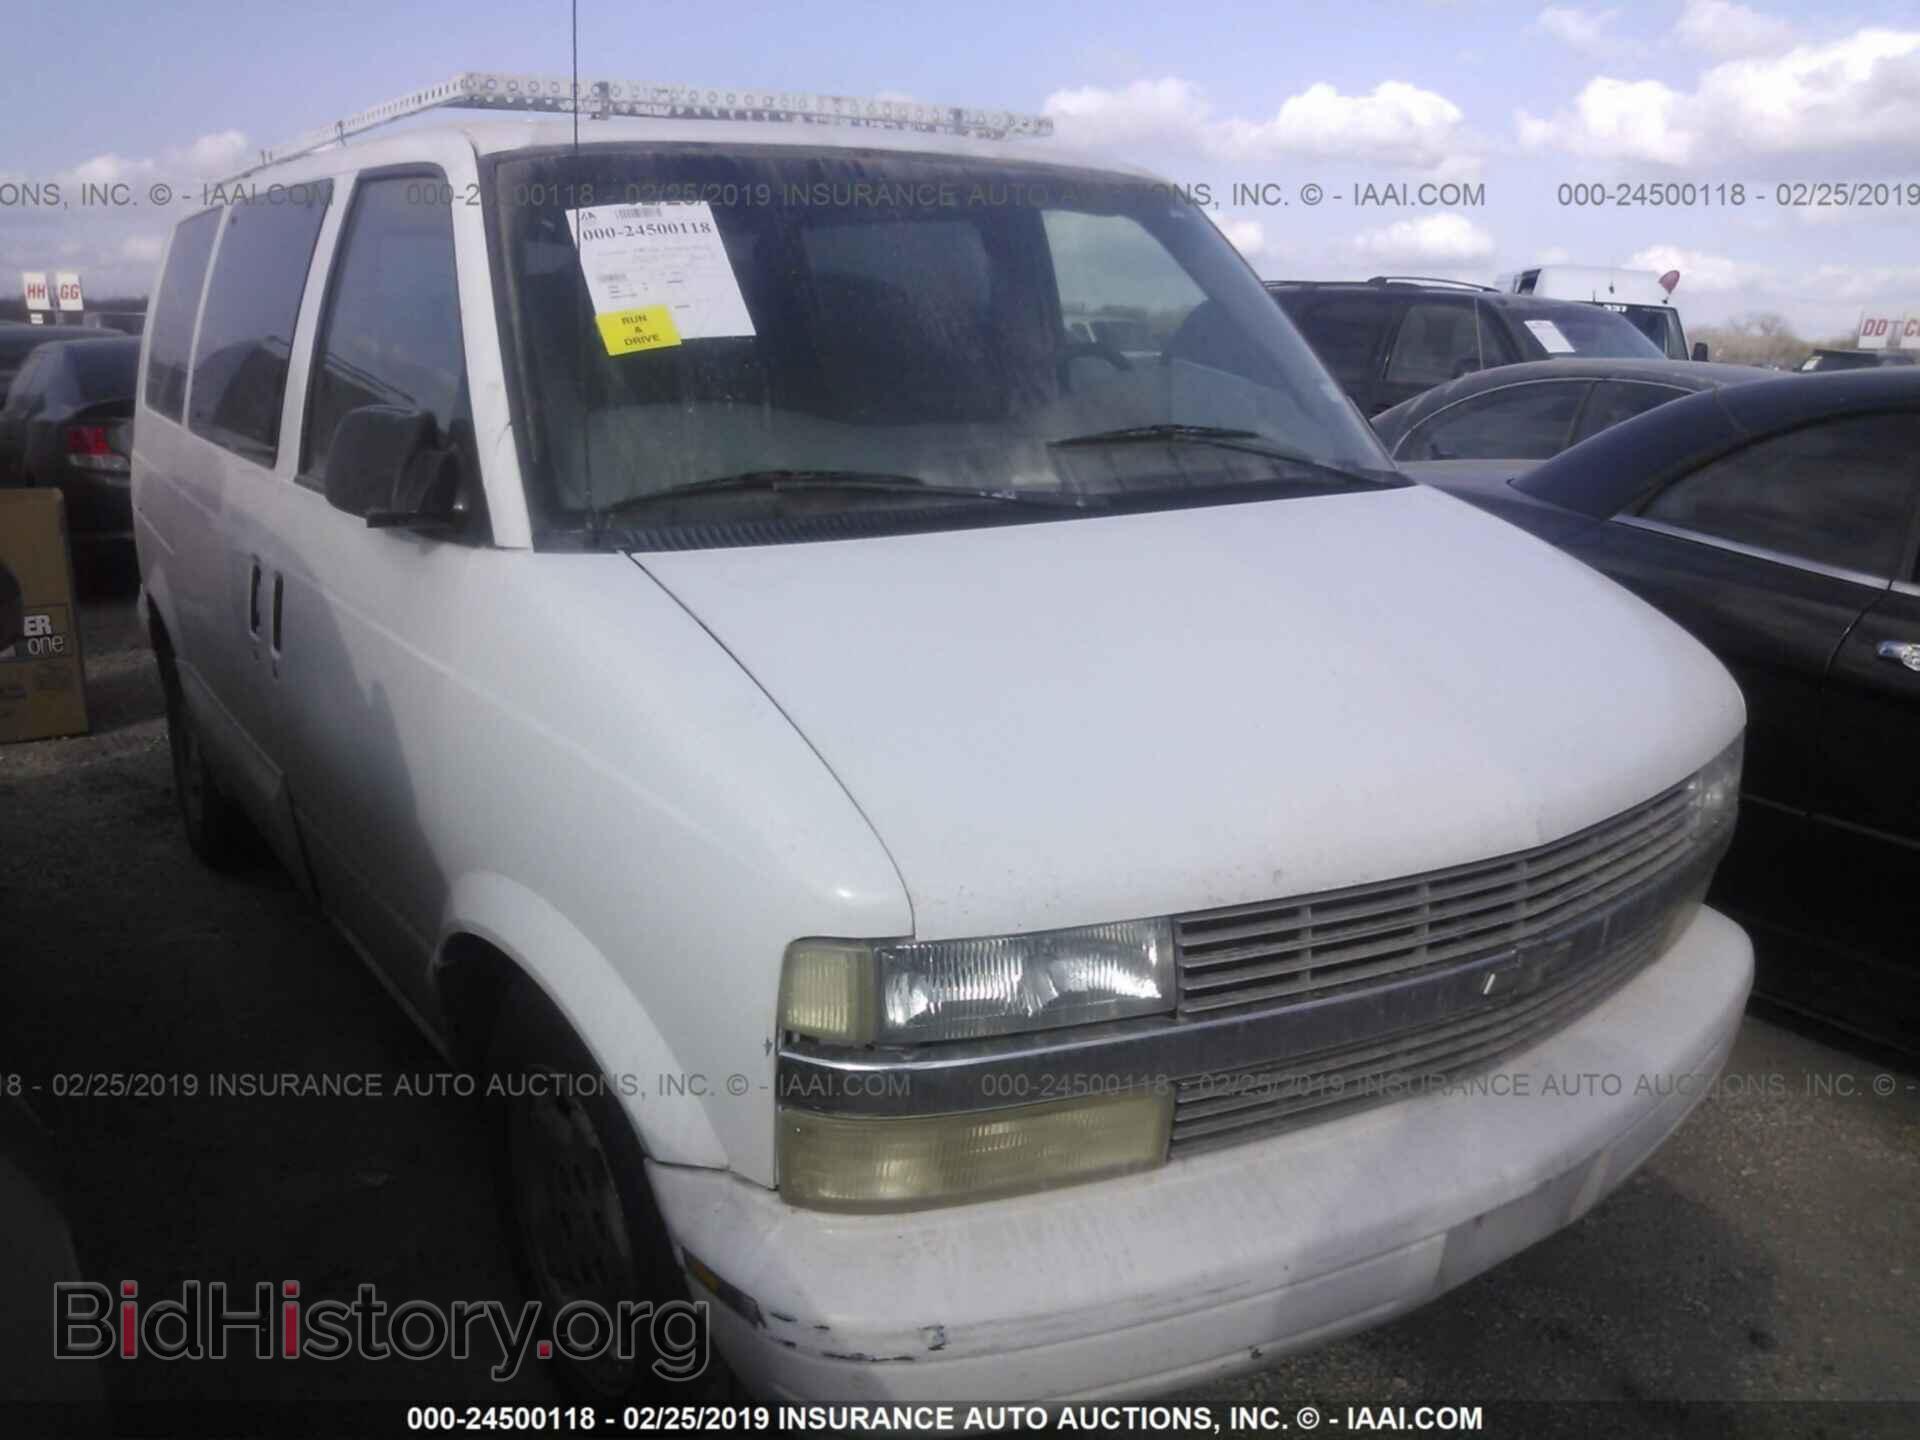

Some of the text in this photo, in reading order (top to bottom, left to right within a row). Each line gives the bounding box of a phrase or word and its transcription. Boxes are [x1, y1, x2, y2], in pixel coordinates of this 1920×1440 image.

[582, 221, 712, 241] 000-24500118
[26, 283, 46, 300] HH
[60, 283, 81, 300] GG
[621, 314, 649, 325] RUN
[624, 333, 661, 346] DRIVE
[23, 614, 52, 637] ER
[27, 635, 65, 656] one
